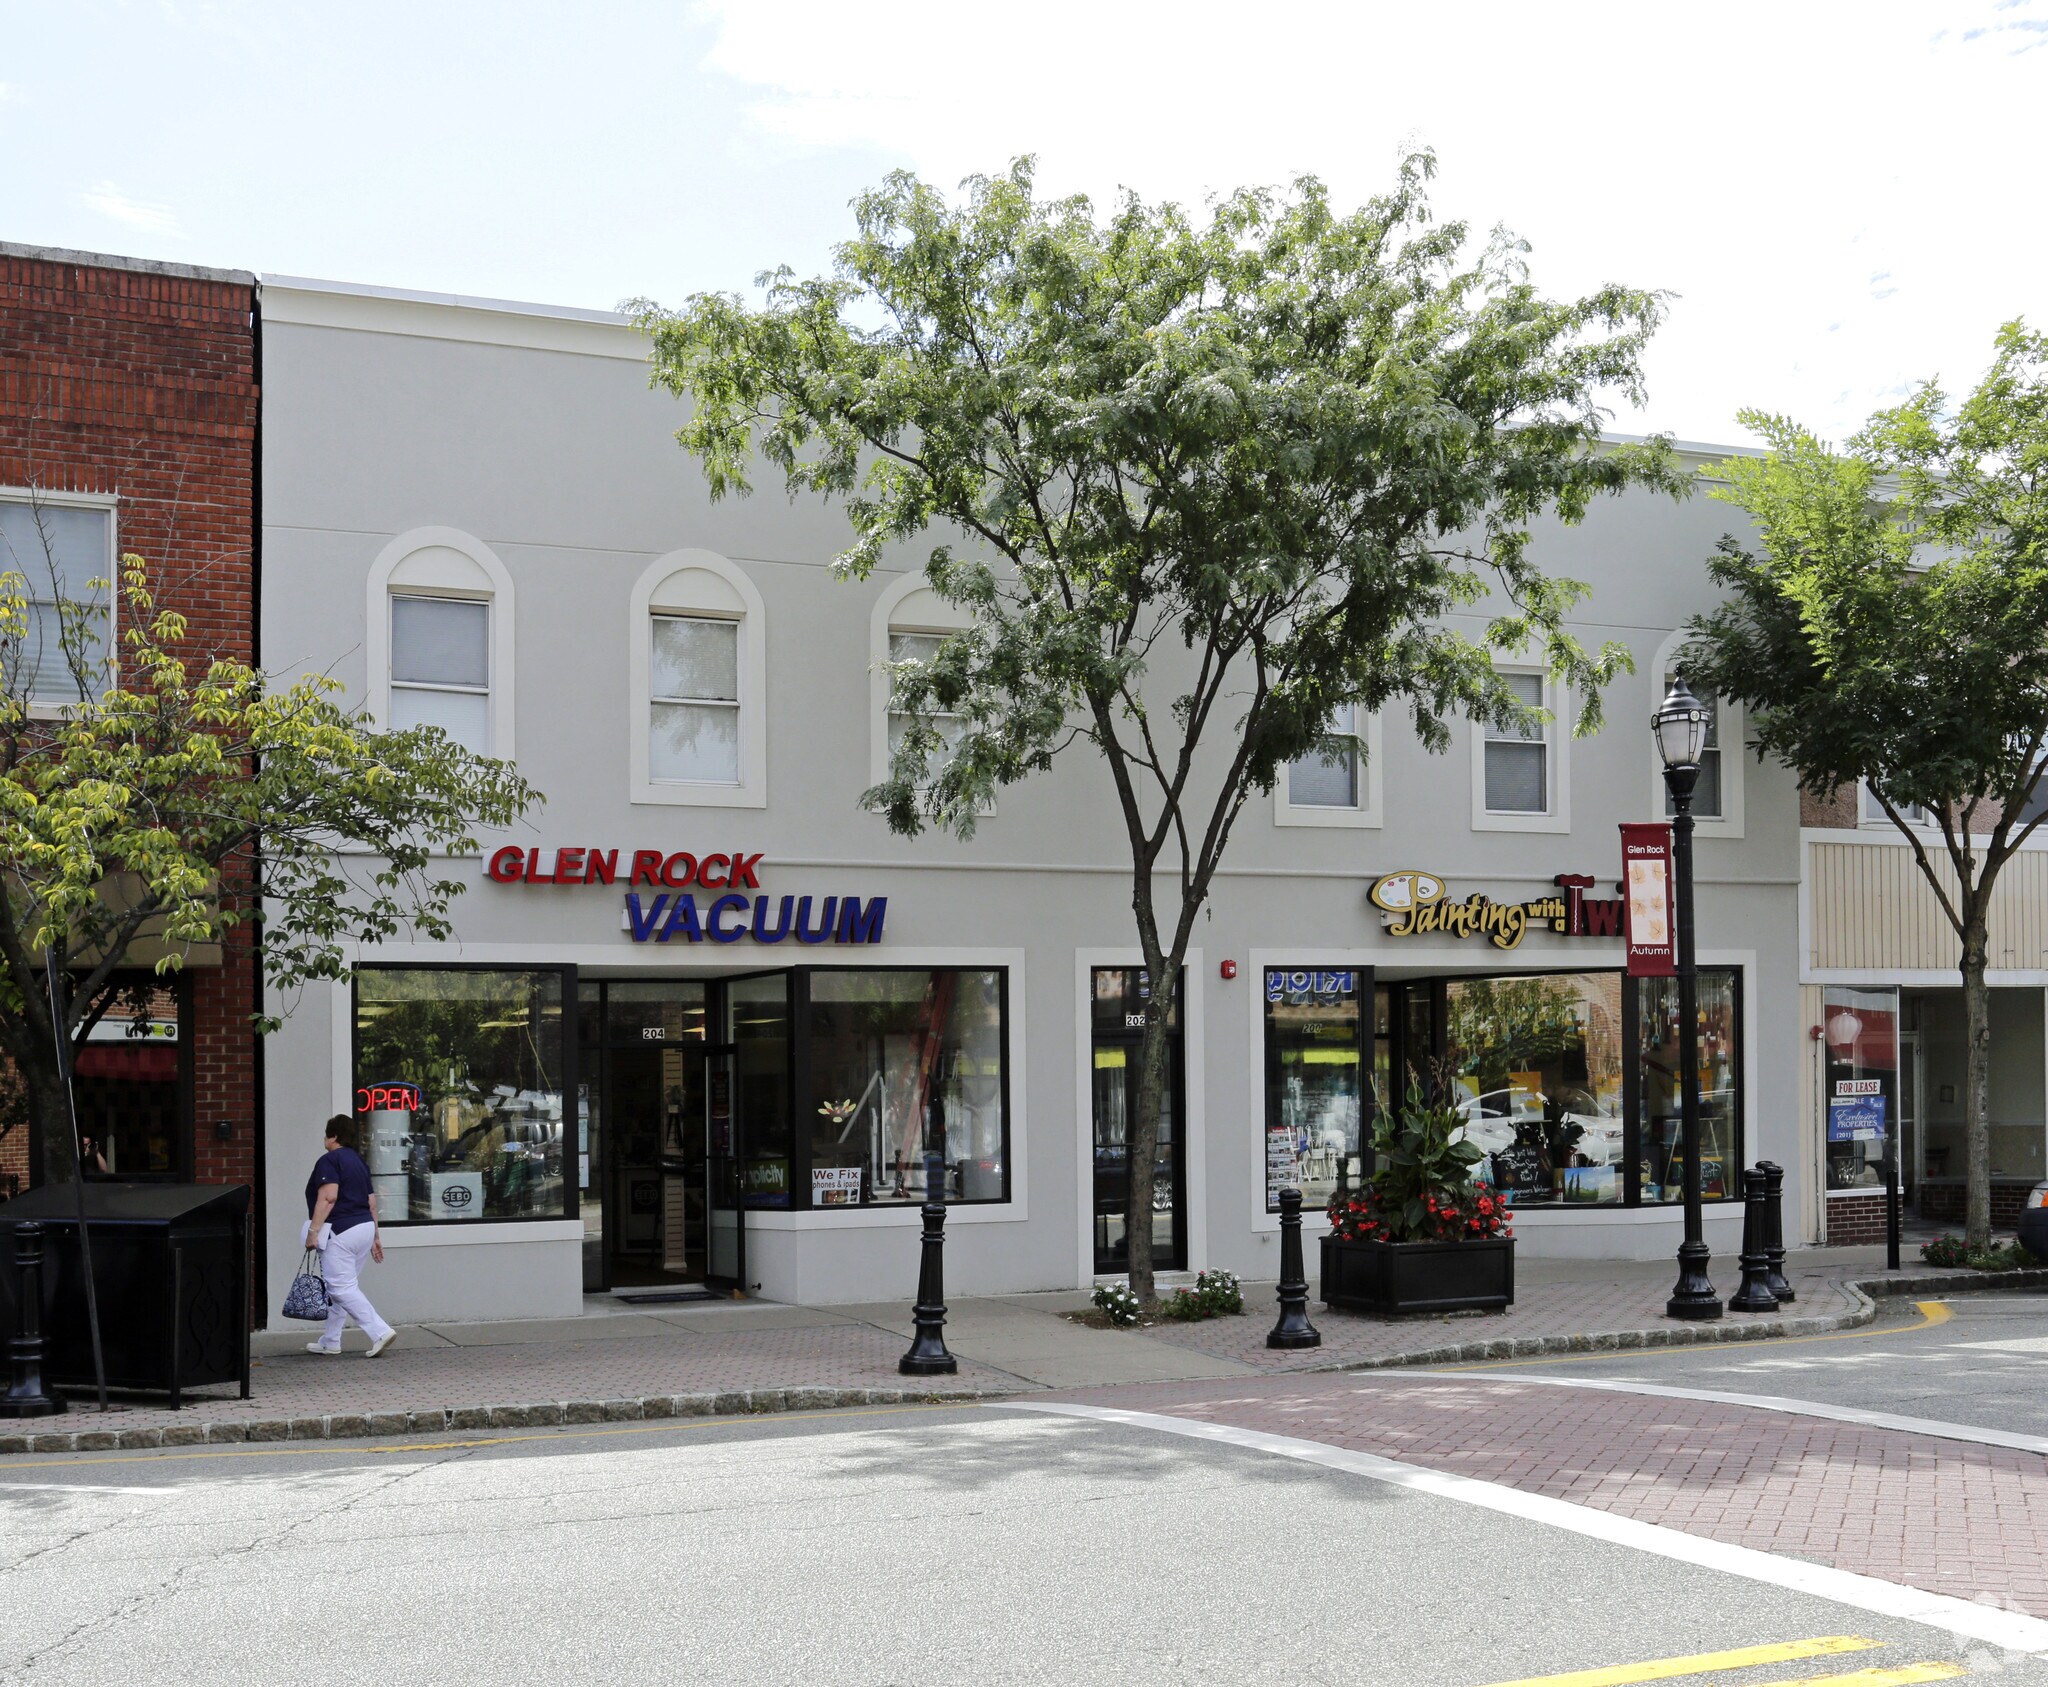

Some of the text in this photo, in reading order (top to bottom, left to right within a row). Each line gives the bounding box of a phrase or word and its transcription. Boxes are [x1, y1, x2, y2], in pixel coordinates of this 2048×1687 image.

[1627, 845, 1665, 854] Glen Rock
[489, 846, 765, 889] GLEN ROCK
[1368, 870, 1526, 951] Painting
[1528, 898, 1566, 918] with
[1555, 919, 1566, 933] a
[625, 893, 889, 944] VACUUM
[1630, 945, 1670, 955] Autumn
[1126, 1016, 1146, 1026] 202
[1302, 1023, 1322, 1033] 200
[644, 1029, 664, 1039] 204
[1838, 1081, 1878, 1093] FOR LEASE
[357, 1088, 419, 1112] OPEN
[1835, 1110, 1878, 1121] Exclusive
[1837, 1120, 1878, 1128] PROPERTIES
[813, 1169, 858, 1180] We Fix
[812, 1180, 860, 1189] phones & ipads
[443, 1192, 470, 1201] SEBO
